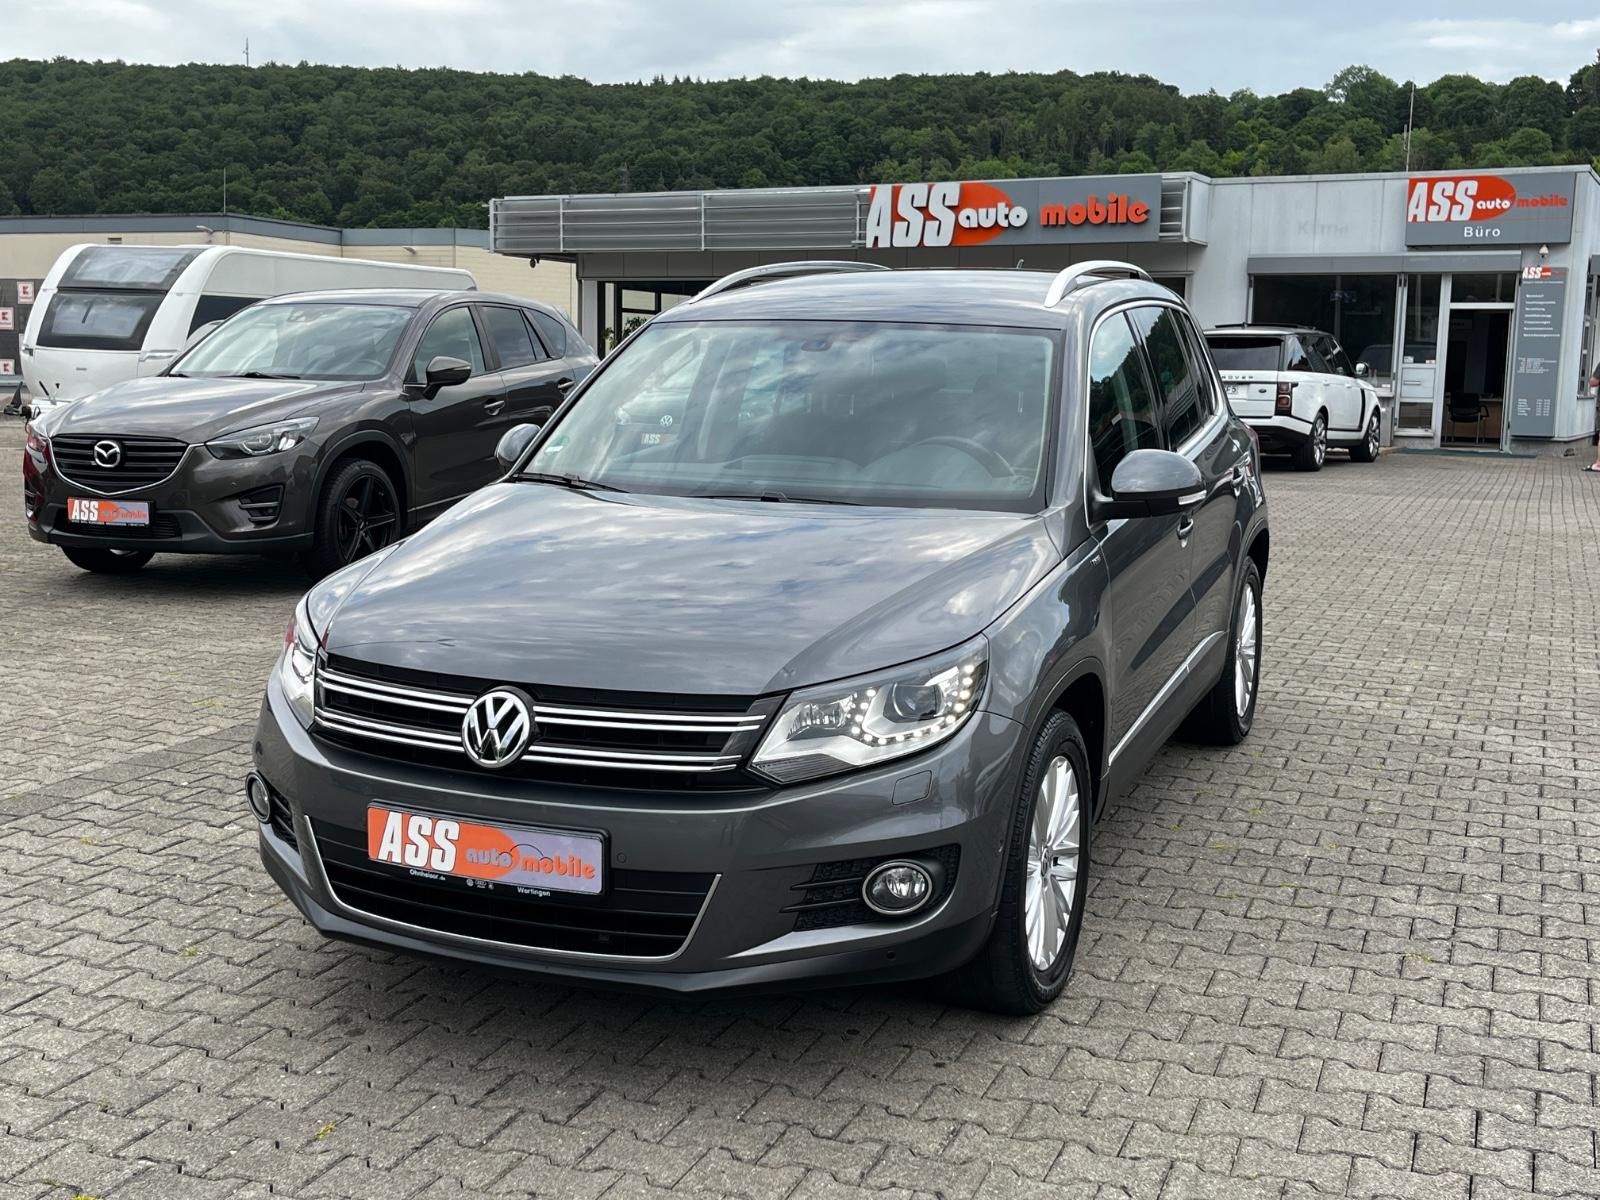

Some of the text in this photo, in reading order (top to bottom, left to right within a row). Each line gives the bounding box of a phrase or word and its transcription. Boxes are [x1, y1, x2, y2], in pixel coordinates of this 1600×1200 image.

[866, 182, 1150, 248] ASS auto mobile
[1408, 179, 1568, 222] ASS auto mobile
[1464, 226, 1501, 238] Büro
[1522, 267, 1543, 279] ASS
[72, 500, 98, 520] ASS
[378, 811, 596, 879] ASS auto mobile
